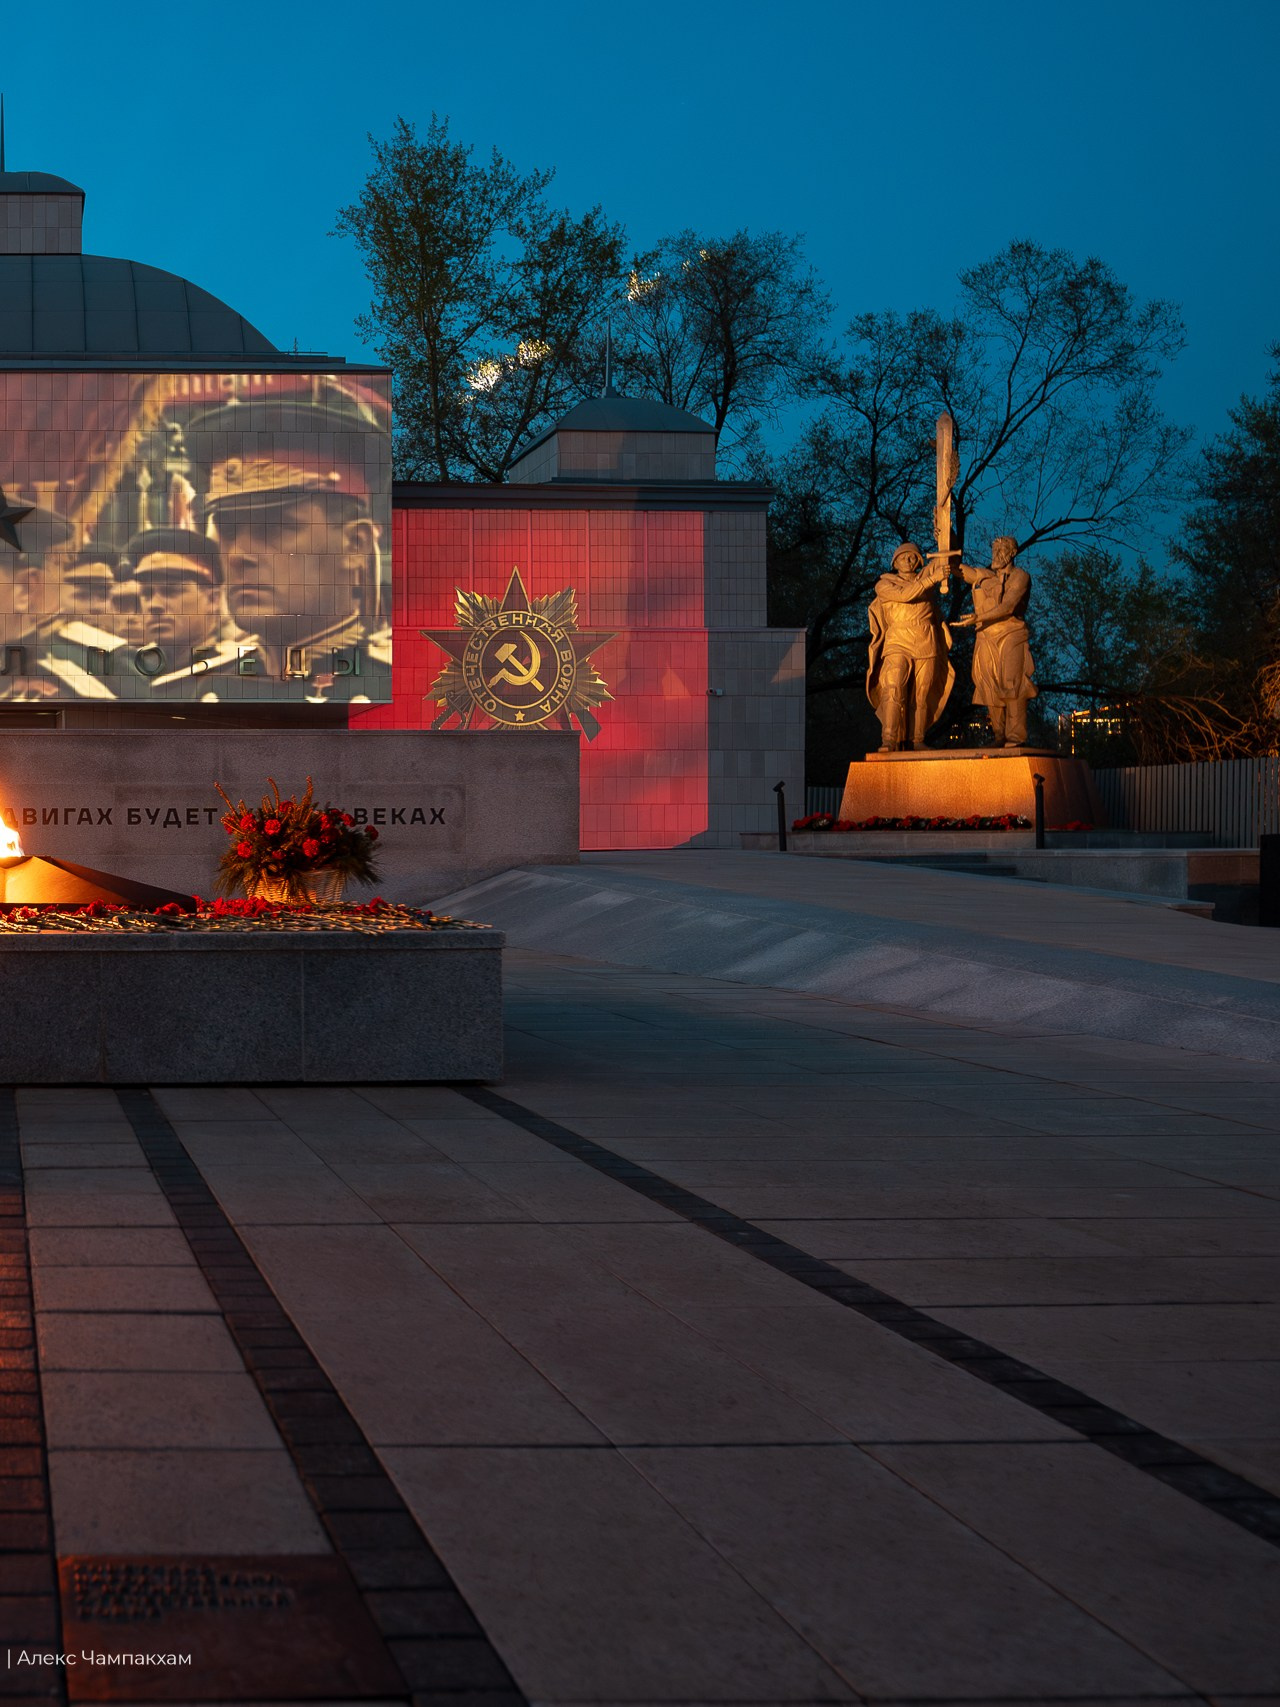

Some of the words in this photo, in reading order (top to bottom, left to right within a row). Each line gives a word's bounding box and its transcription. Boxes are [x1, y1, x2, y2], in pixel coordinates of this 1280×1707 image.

[86, 645, 360, 681] ПОБЕДЫ
[126, 806, 219, 829] БУДЕТ
[354, 806, 447, 826] ВЕКАХ
